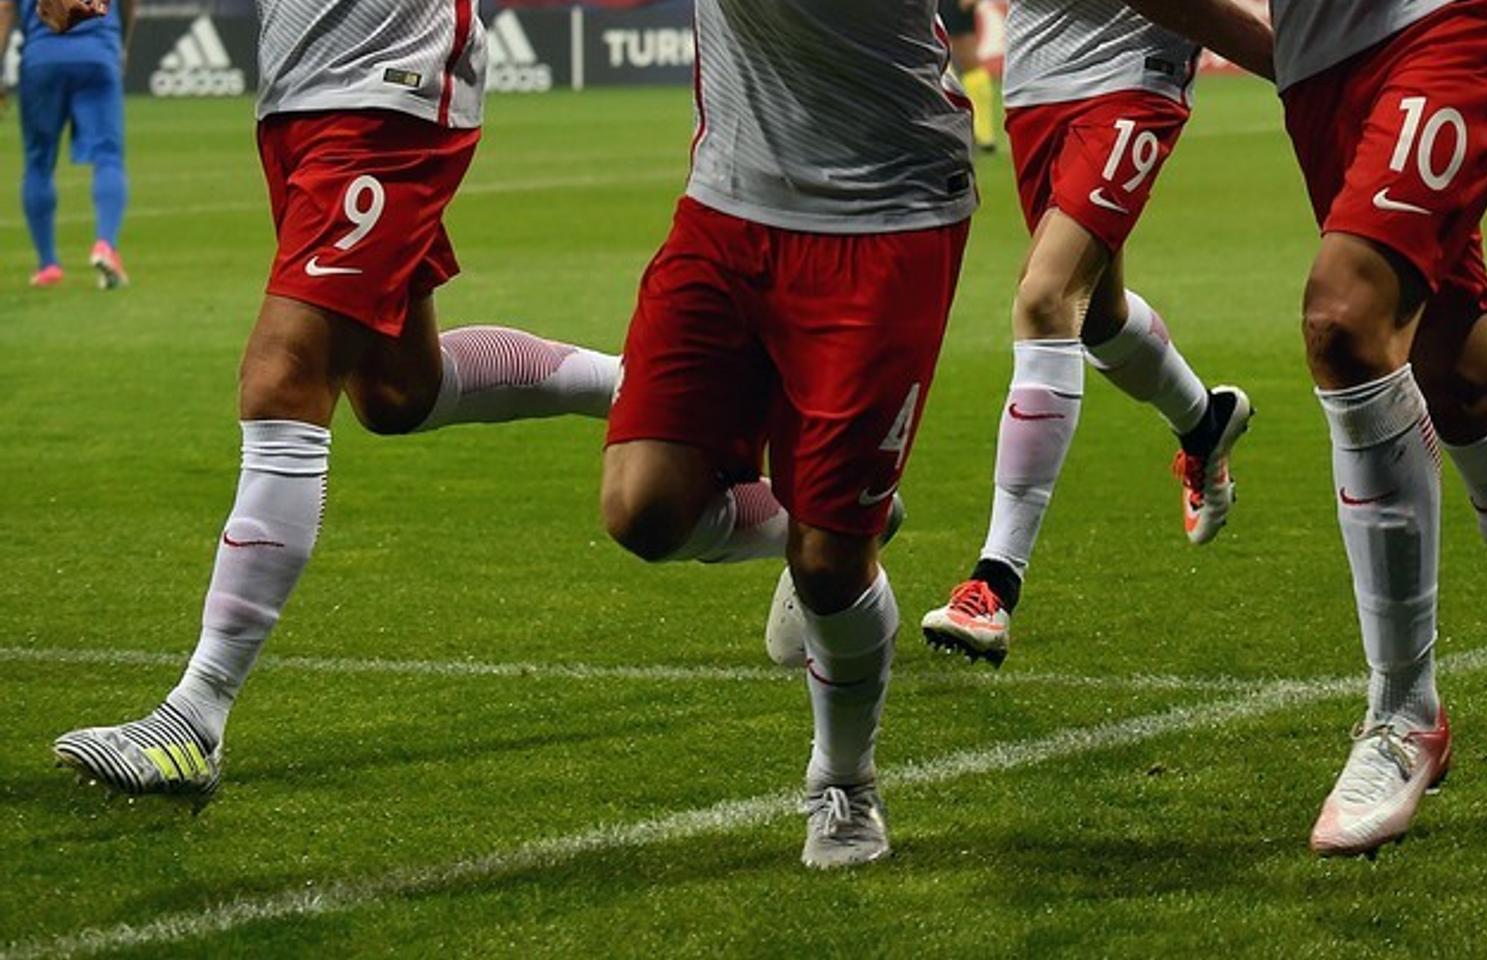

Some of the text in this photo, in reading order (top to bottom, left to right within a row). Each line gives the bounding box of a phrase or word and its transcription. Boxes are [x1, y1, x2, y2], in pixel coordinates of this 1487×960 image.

[150, 68, 245, 96] adidas
[1102, 119, 1159, 193] 19
[1390, 96, 1468, 191] 10
[333, 174, 386, 251] 9
[877, 382, 920, 469] 4
